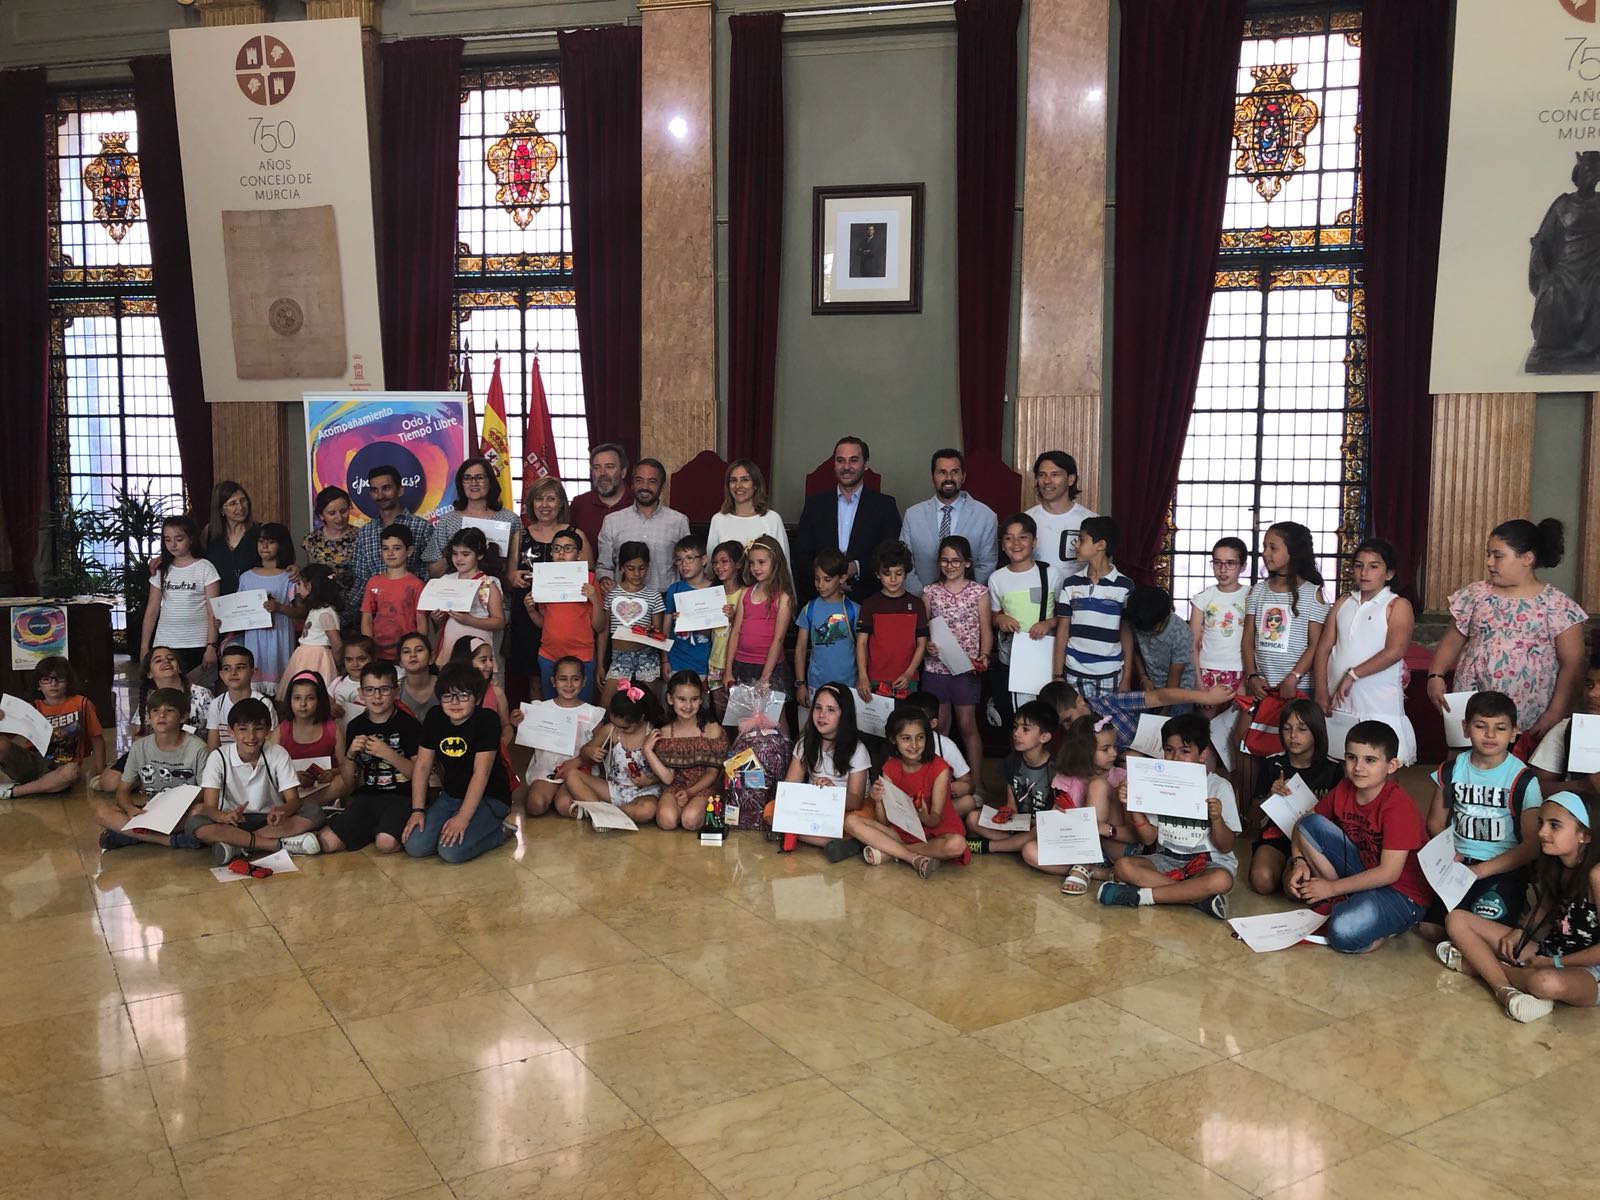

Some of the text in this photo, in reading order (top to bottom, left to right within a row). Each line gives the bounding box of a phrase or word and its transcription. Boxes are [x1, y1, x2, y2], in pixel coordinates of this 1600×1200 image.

[247, 117, 296, 153] 750
[1558, 126, 1600, 140] MUR
[259, 158, 292, 170] AÑOS
[240, 173, 312, 187] CONCEJO DE
[255, 188, 301, 201] MURCIA
[318, 407, 393, 440] Acompañamiento
[397, 417, 458, 443] Tiempo Libre
[402, 413, 432, 431] Ocio y
[1453, 782, 1510, 808] STREET
